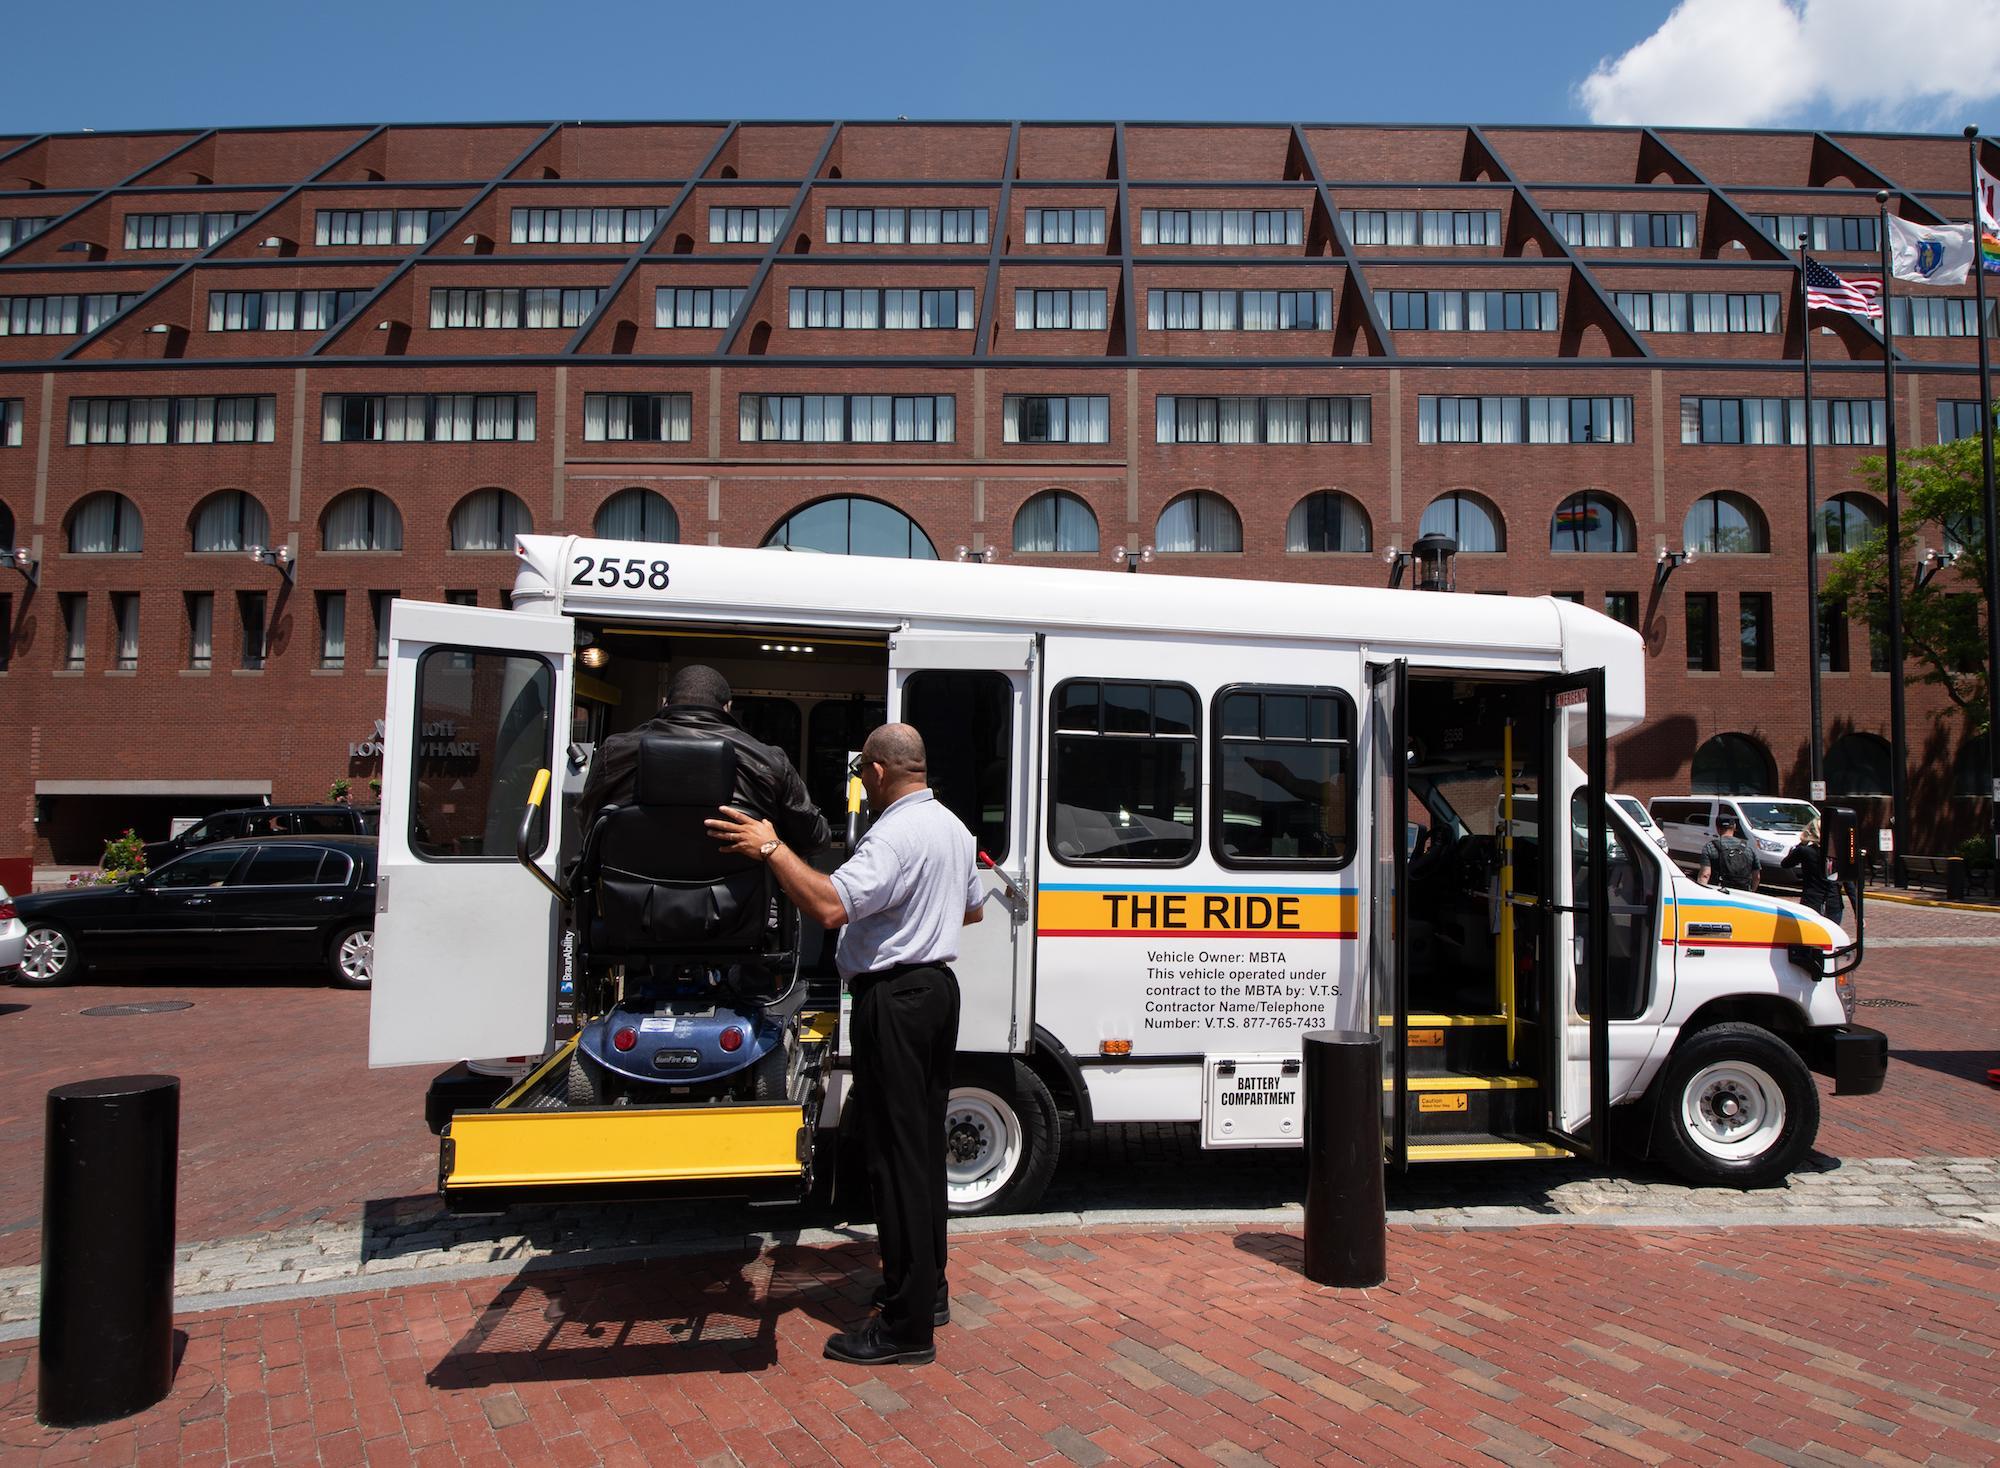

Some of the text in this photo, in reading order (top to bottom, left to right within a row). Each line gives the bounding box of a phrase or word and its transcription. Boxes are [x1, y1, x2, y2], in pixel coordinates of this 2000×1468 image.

[571, 556, 670, 590] 2558
[1556, 689, 1587, 706] EMERGENC
[349, 742, 385, 758] LON
[1103, 895, 1300, 929] THE RIDE
[561, 930, 575, 981] BraunAbility
[1147, 951, 1286, 963] Vehicle Owner: MBTA
[1147, 968, 1327, 982] This vehicle operated under
[1146, 985, 1343, 999] contract to the MBTA by: V.T.S.
[1145, 1001, 1325, 1015] Contractor Name/Telephone
[1144, 1017, 1326, 1029] Number: V.T.S. 877-765-7433
[655, 1055, 682, 1064] SunFire
[1237, 1077, 1280, 1090] BATTERY
[1221, 1092, 1296, 1106] COMPARTMENT
